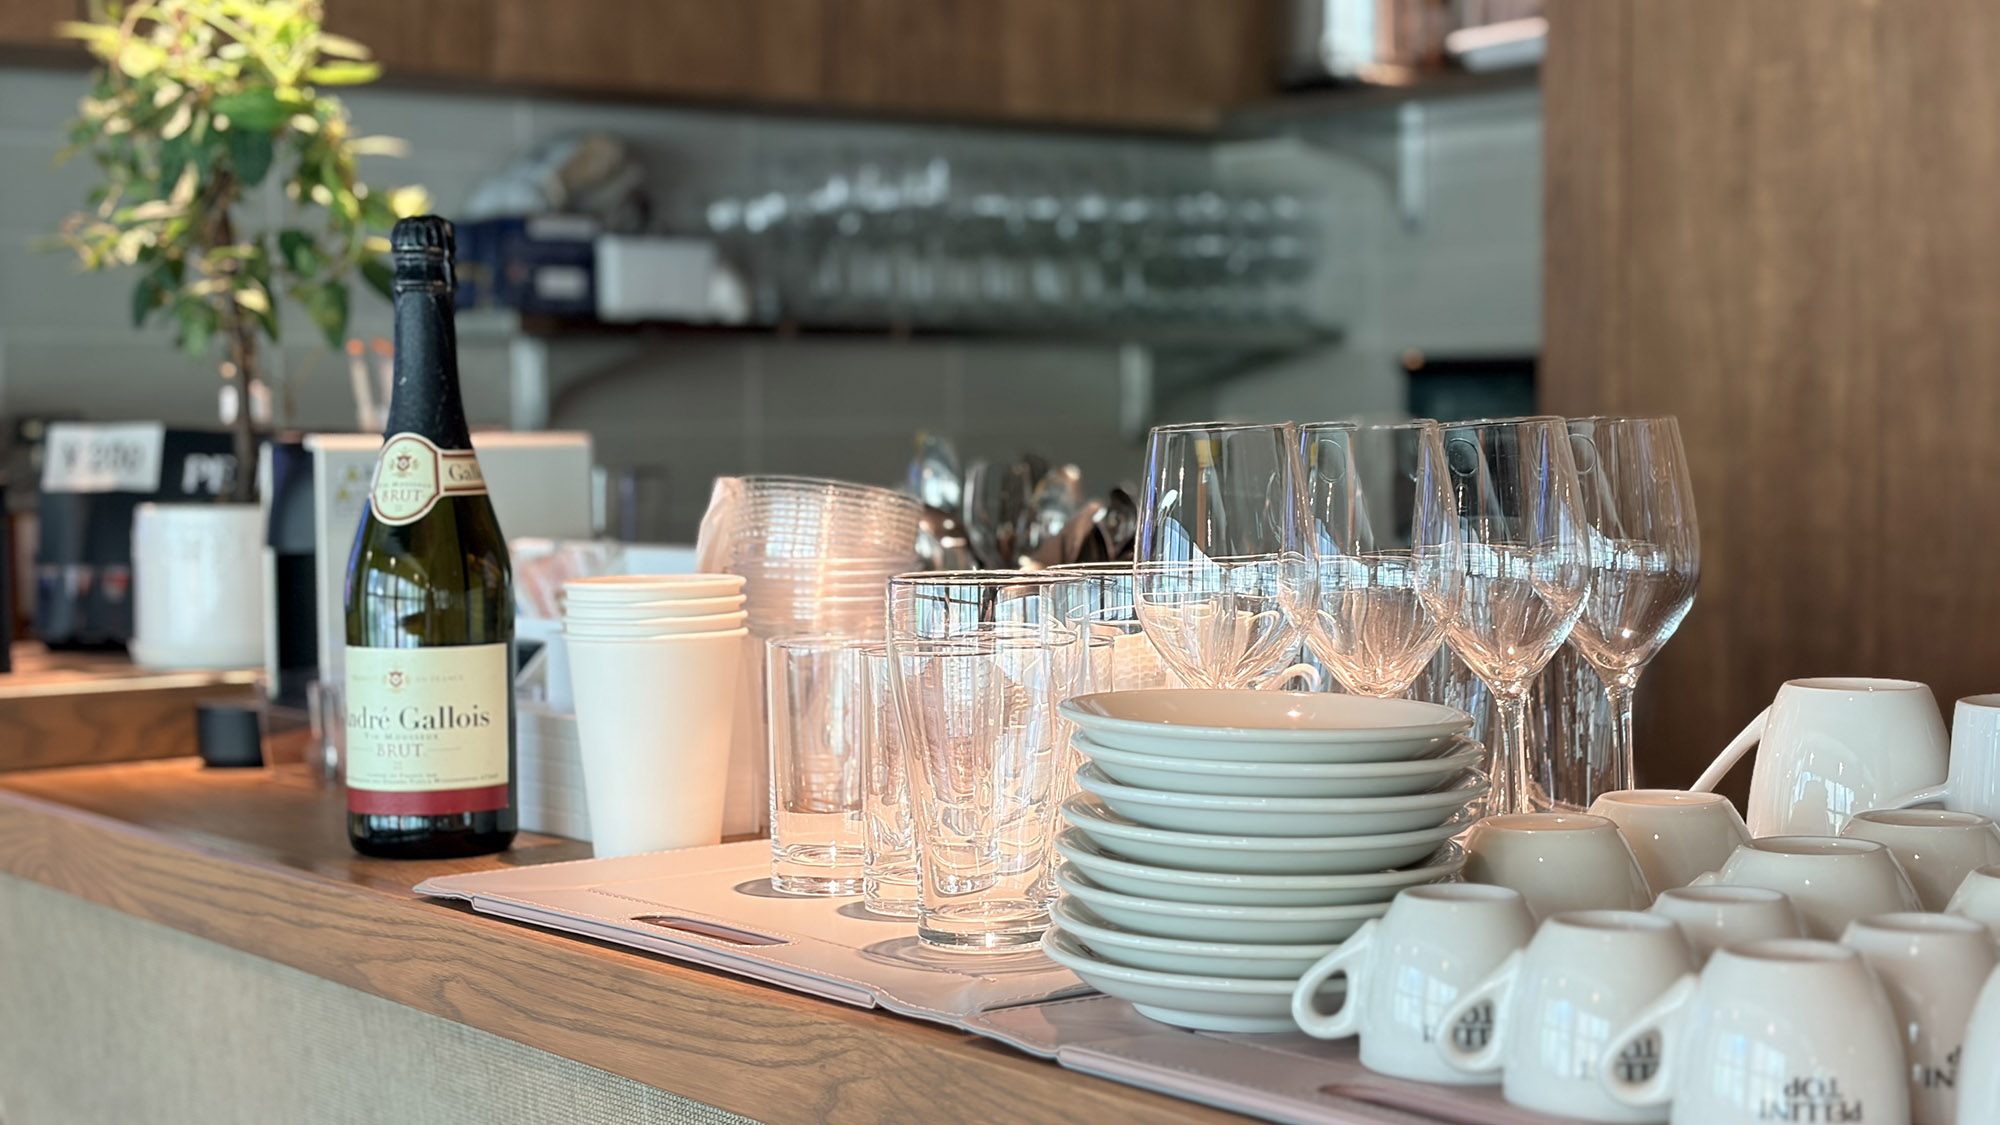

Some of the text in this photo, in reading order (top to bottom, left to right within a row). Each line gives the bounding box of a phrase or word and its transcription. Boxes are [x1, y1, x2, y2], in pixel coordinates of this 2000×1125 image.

[382, 489, 423, 502] BRUT
[348, 704, 491, 731] ndré Gallois
[376, 743, 424, 758] BRUT
[1784, 1078, 1842, 1098] TOP
[1760, 1099, 1862, 1123] PELLINI
